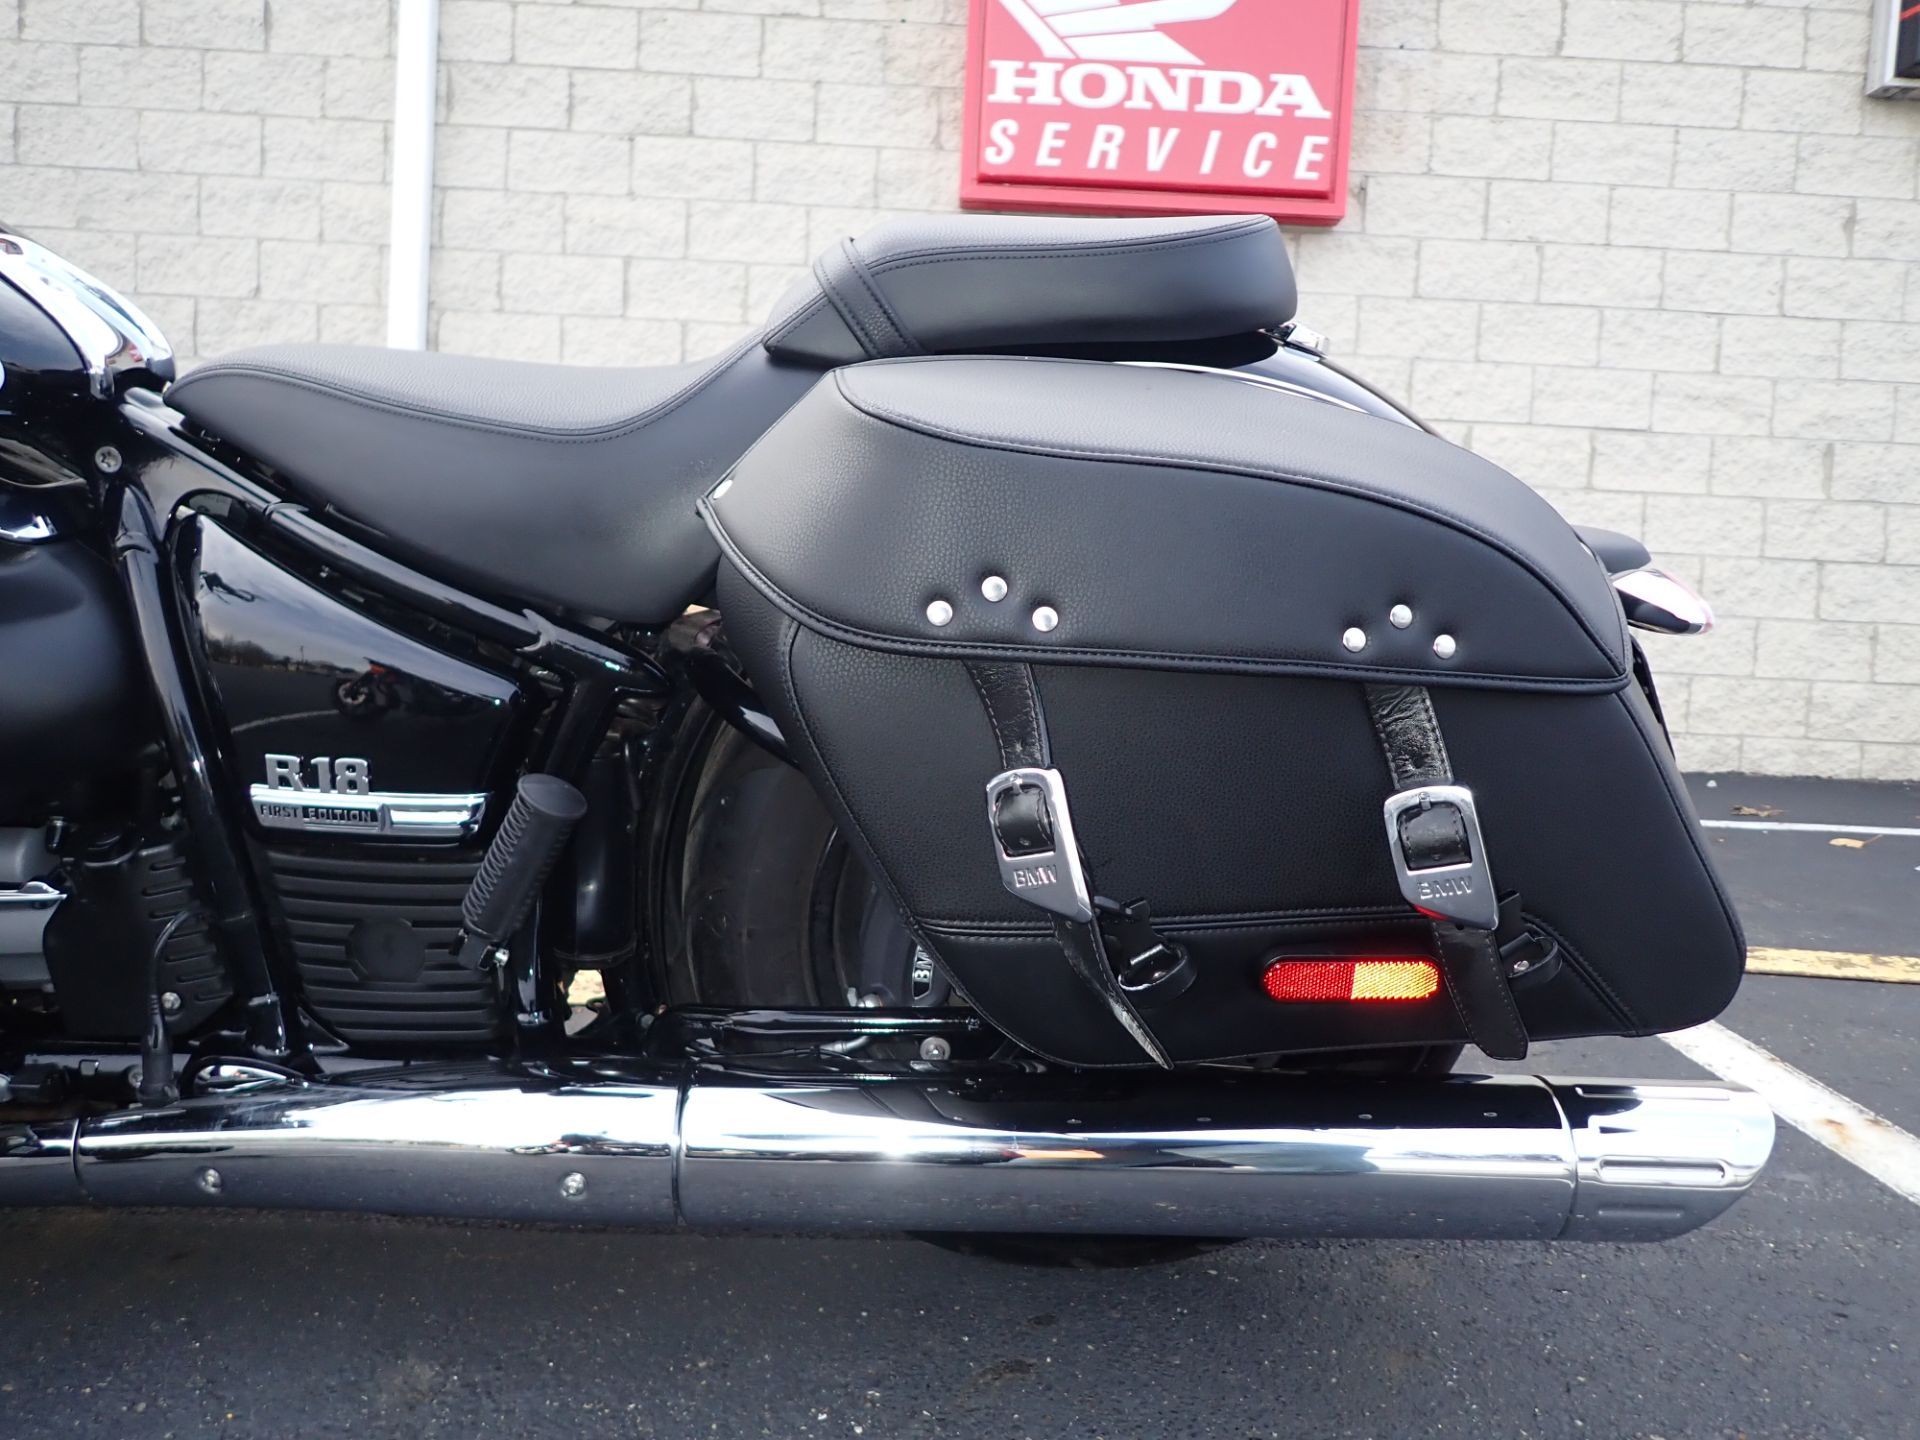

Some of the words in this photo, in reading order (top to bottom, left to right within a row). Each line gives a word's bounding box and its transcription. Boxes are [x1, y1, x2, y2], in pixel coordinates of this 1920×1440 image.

[987, 60, 1331, 119] HONDA
[984, 119, 1330, 181] SERVICE
[264, 753, 304, 791] R
[311, 757, 369, 795] 18
[260, 804, 299, 820] FIRST
[308, 808, 372, 824] EDITION
[1013, 865, 1057, 888] BMW
[1418, 876, 1473, 899] BMW
[914, 946, 932, 983] BM
